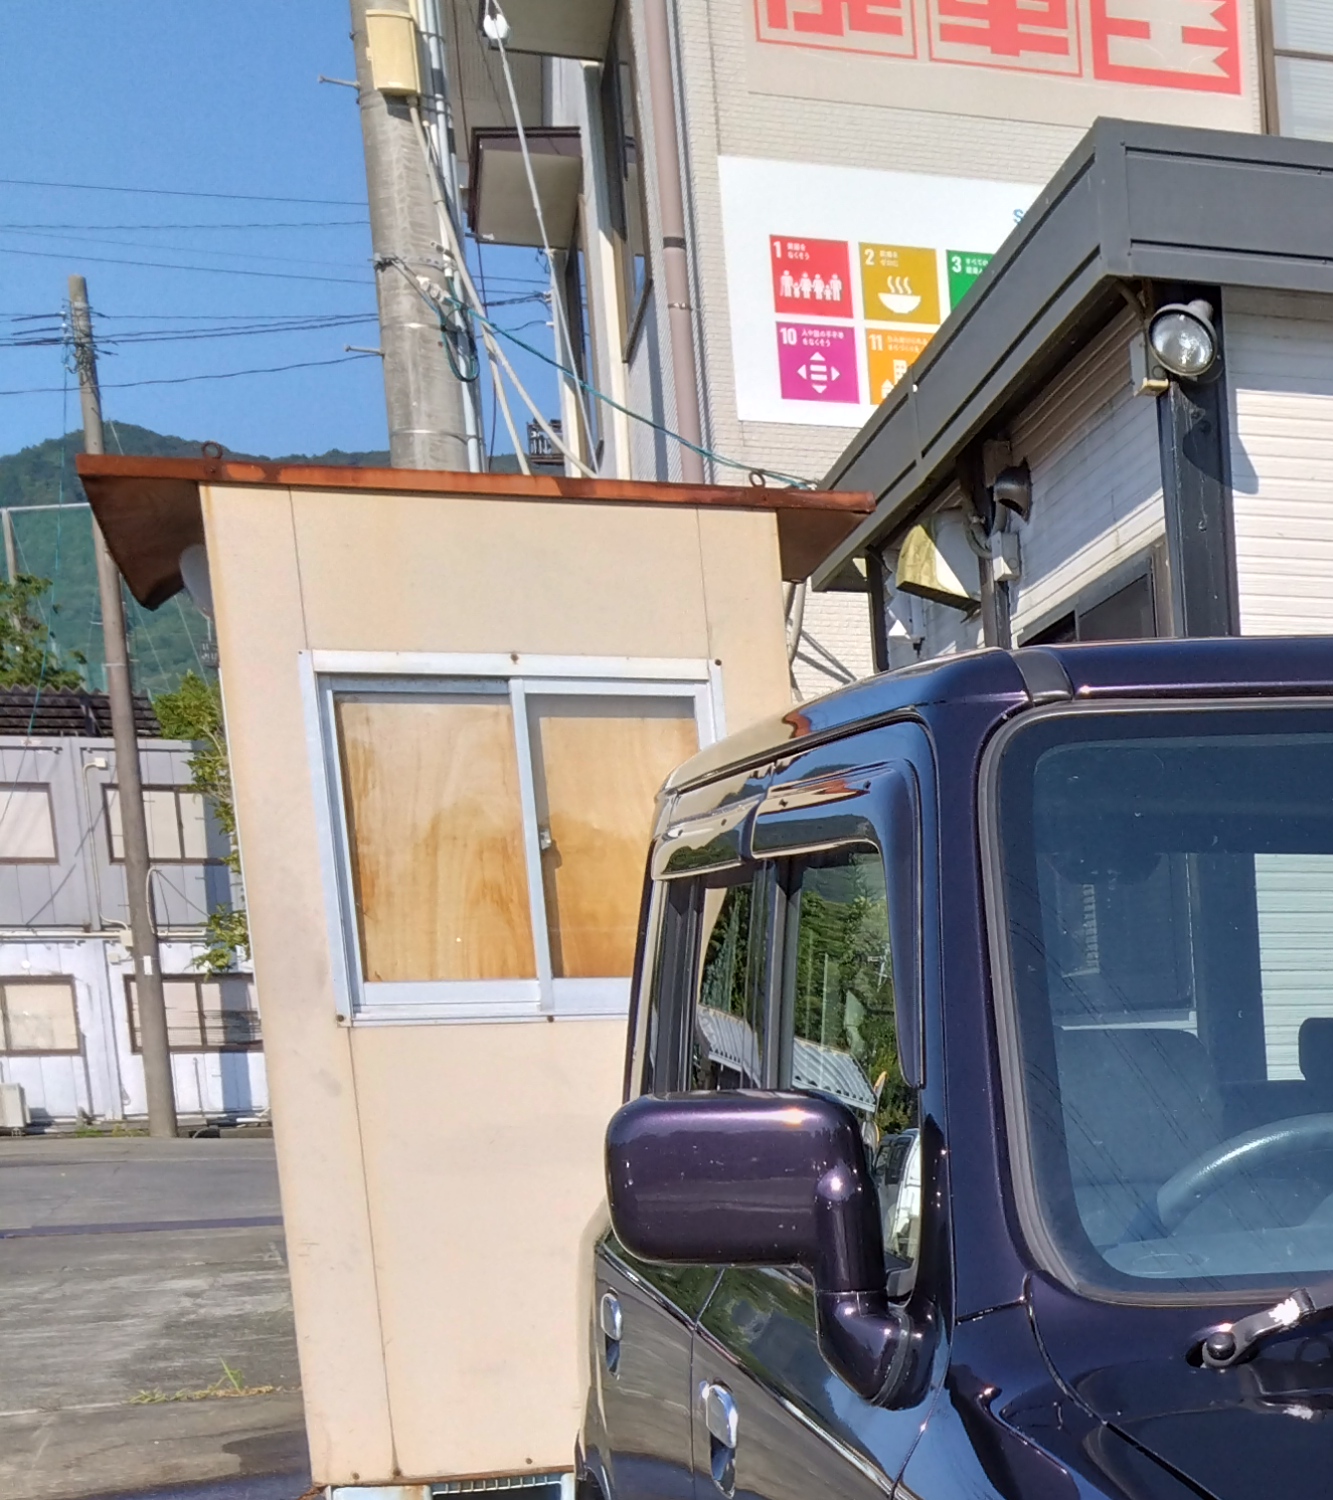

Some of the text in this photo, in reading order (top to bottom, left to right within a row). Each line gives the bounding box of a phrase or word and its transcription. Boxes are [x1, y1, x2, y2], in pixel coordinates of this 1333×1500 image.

[773, 240, 782, 259] 1
[864, 248, 875, 266] 2
[951, 256, 962, 273] 3
[779, 327, 797, 346] 10
[868, 333, 884, 352] 11
